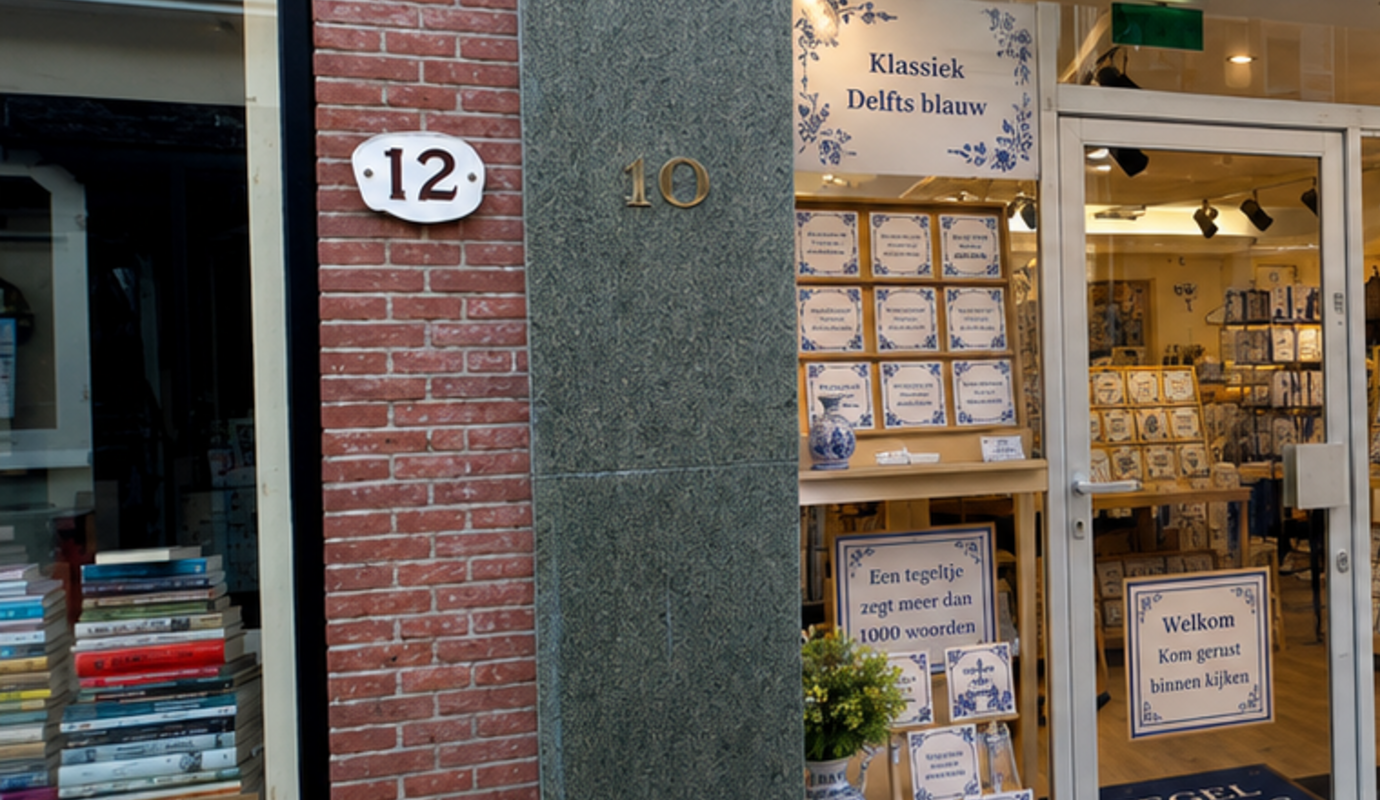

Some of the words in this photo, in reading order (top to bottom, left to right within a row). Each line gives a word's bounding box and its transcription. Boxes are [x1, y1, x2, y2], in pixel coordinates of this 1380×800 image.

[869, 53, 965, 79] Klassiek
[847, 88, 914, 113] Delfts
[921, 92, 988, 116] blauw
[384, 147, 458, 202] 12
[623, 153, 710, 208] 10
[869, 568, 900, 586] Een
[905, 562, 964, 585] tegeltje
[859, 598, 894, 618] zegt
[898, 595, 939, 612] meer
[942, 591, 973, 608] dan
[859, 624, 901, 643] 1000
[905, 619, 976, 639] woorden
[1162, 611, 1235, 634] Welkom
[1158, 648, 1192, 665] Kom
[1196, 642, 1241, 664] gerust
[1149, 678, 1201, 695] binnen
[1204, 670, 1250, 691] kijken
